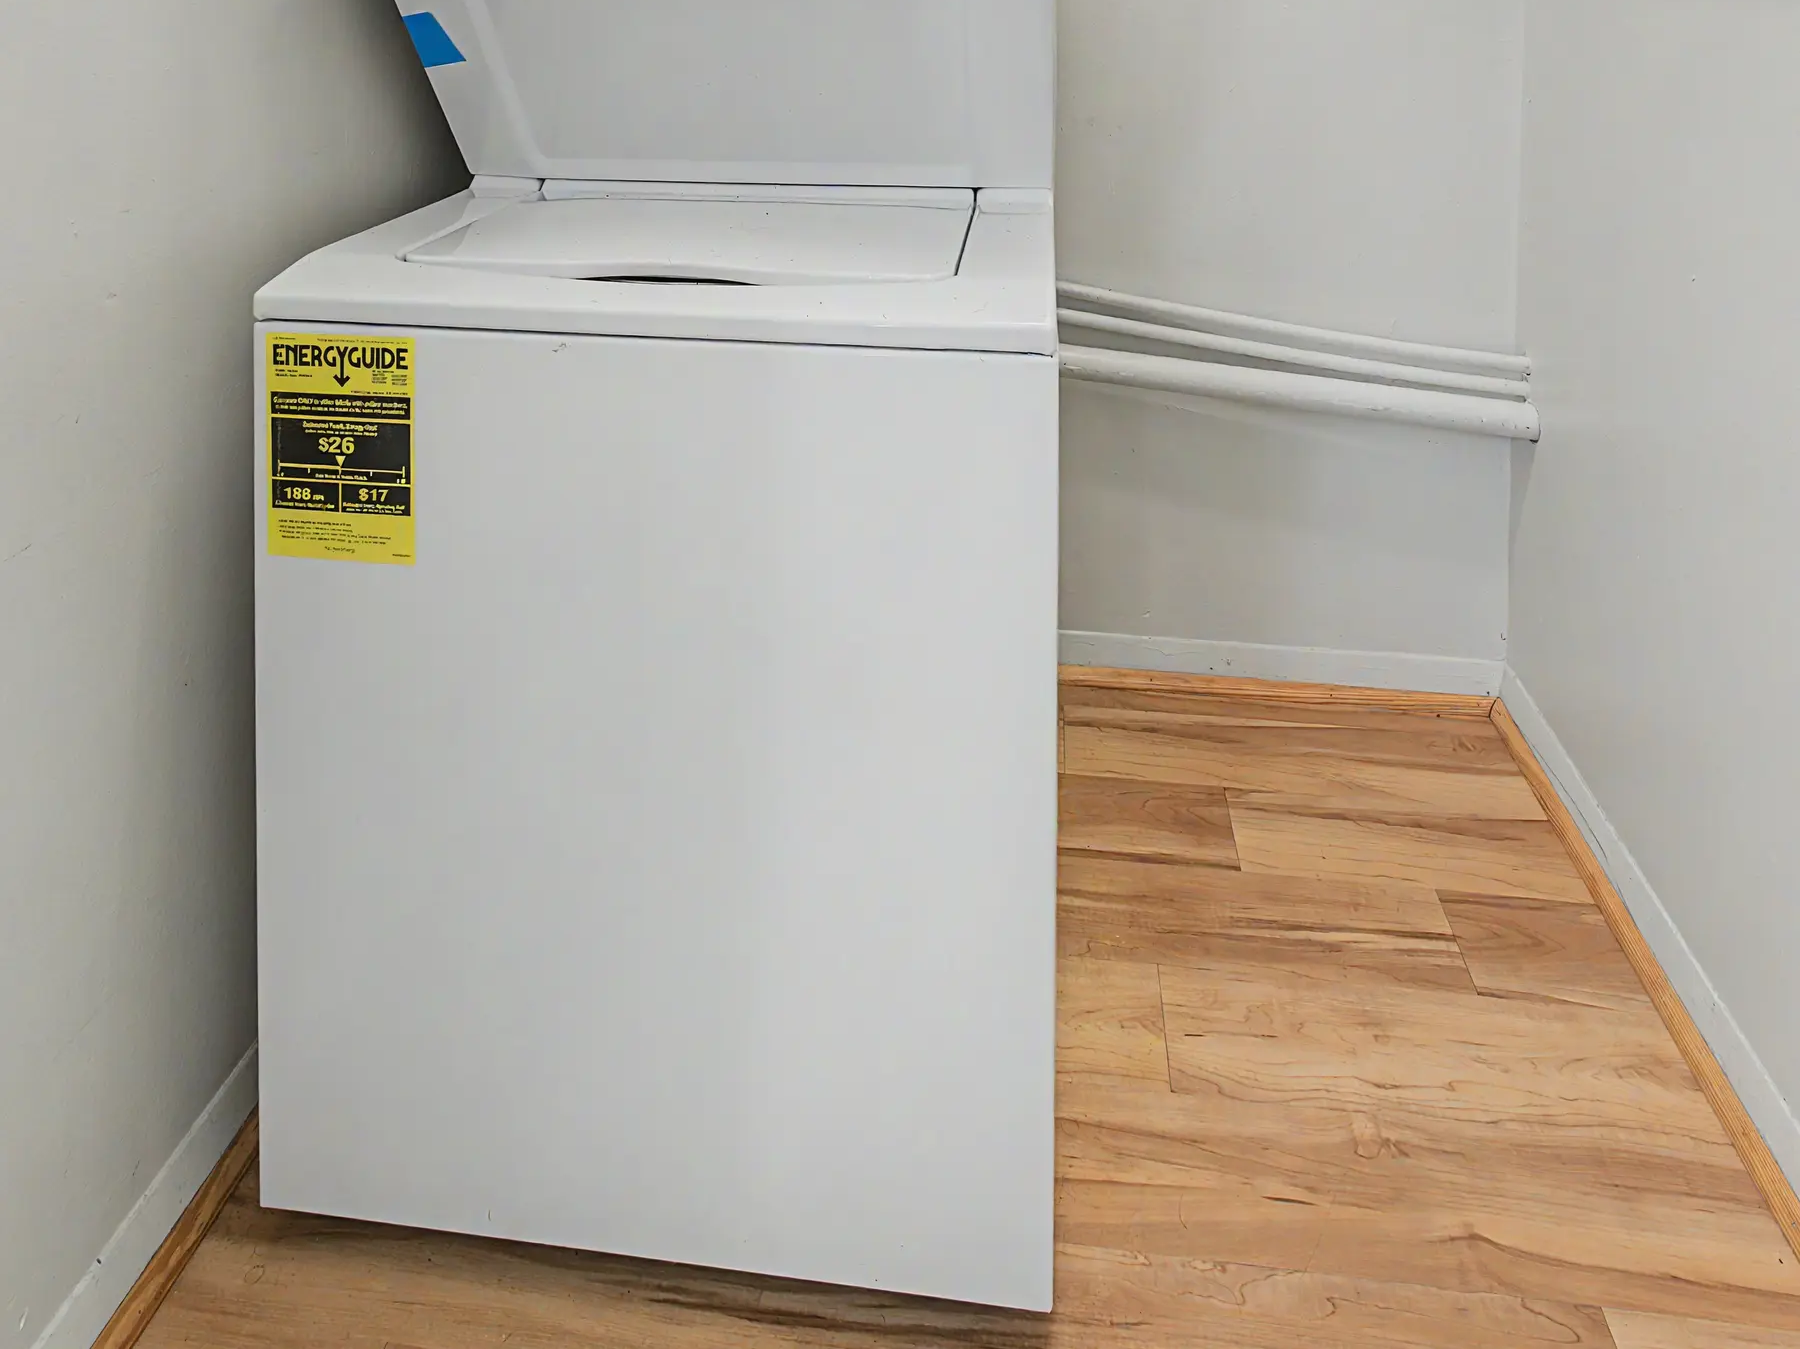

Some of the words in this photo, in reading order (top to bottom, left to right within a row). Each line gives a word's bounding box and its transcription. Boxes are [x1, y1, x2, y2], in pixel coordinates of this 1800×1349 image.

[272, 343, 409, 370] ENERGYGUIDE
[318, 436, 355, 454] $26
[358, 487, 390, 502] $17
